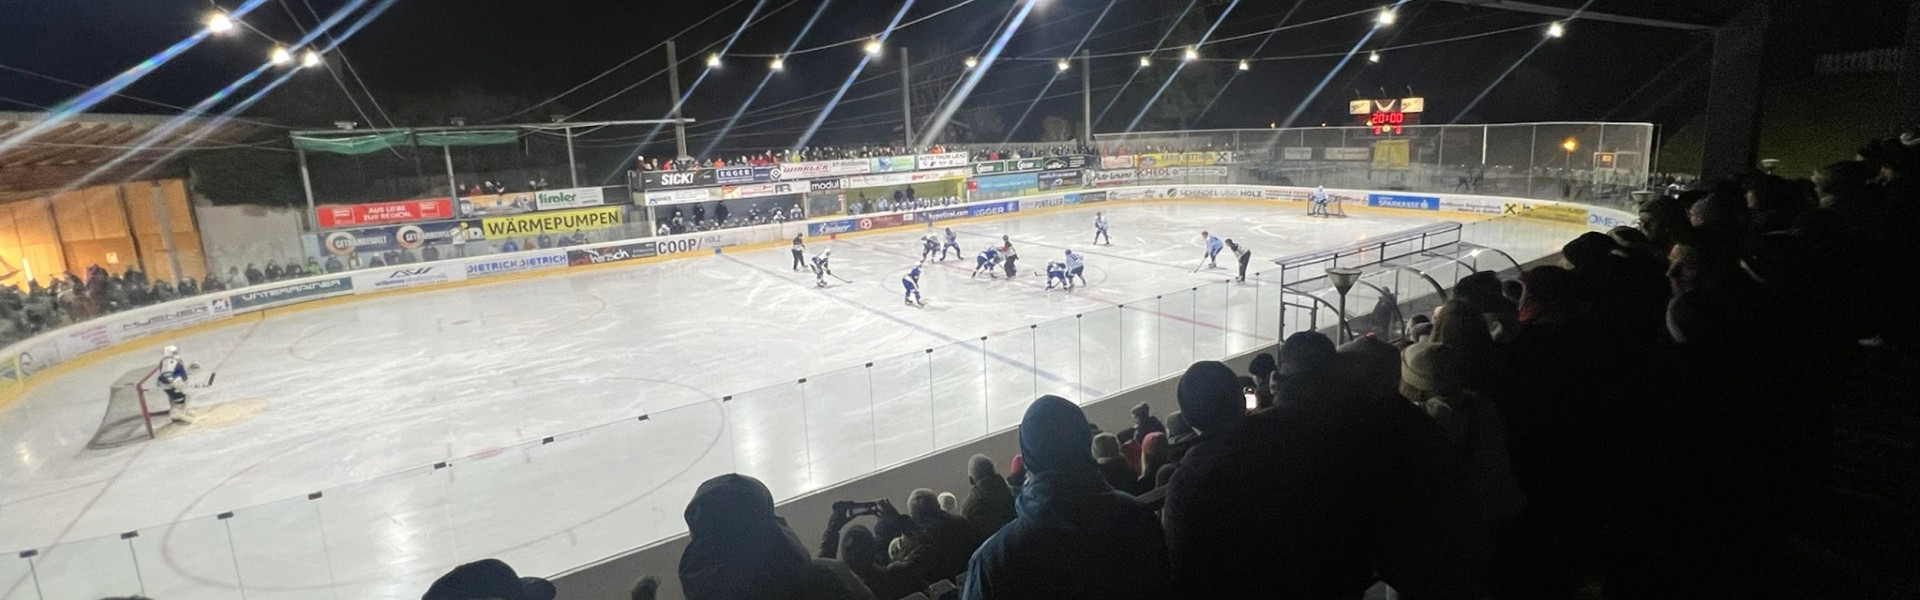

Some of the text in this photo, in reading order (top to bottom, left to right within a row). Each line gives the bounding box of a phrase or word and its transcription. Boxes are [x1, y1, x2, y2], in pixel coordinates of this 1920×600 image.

[1372, 113, 1404, 124] 20:00
[720, 168, 751, 178] EGGER
[661, 172, 694, 186] SICK!
[811, 180, 839, 191] modul
[1240, 190, 1262, 198] HOLZ
[1378, 200, 1420, 209] SPARKASSE
[488, 210, 619, 236] WÄRMEPUMPEN
